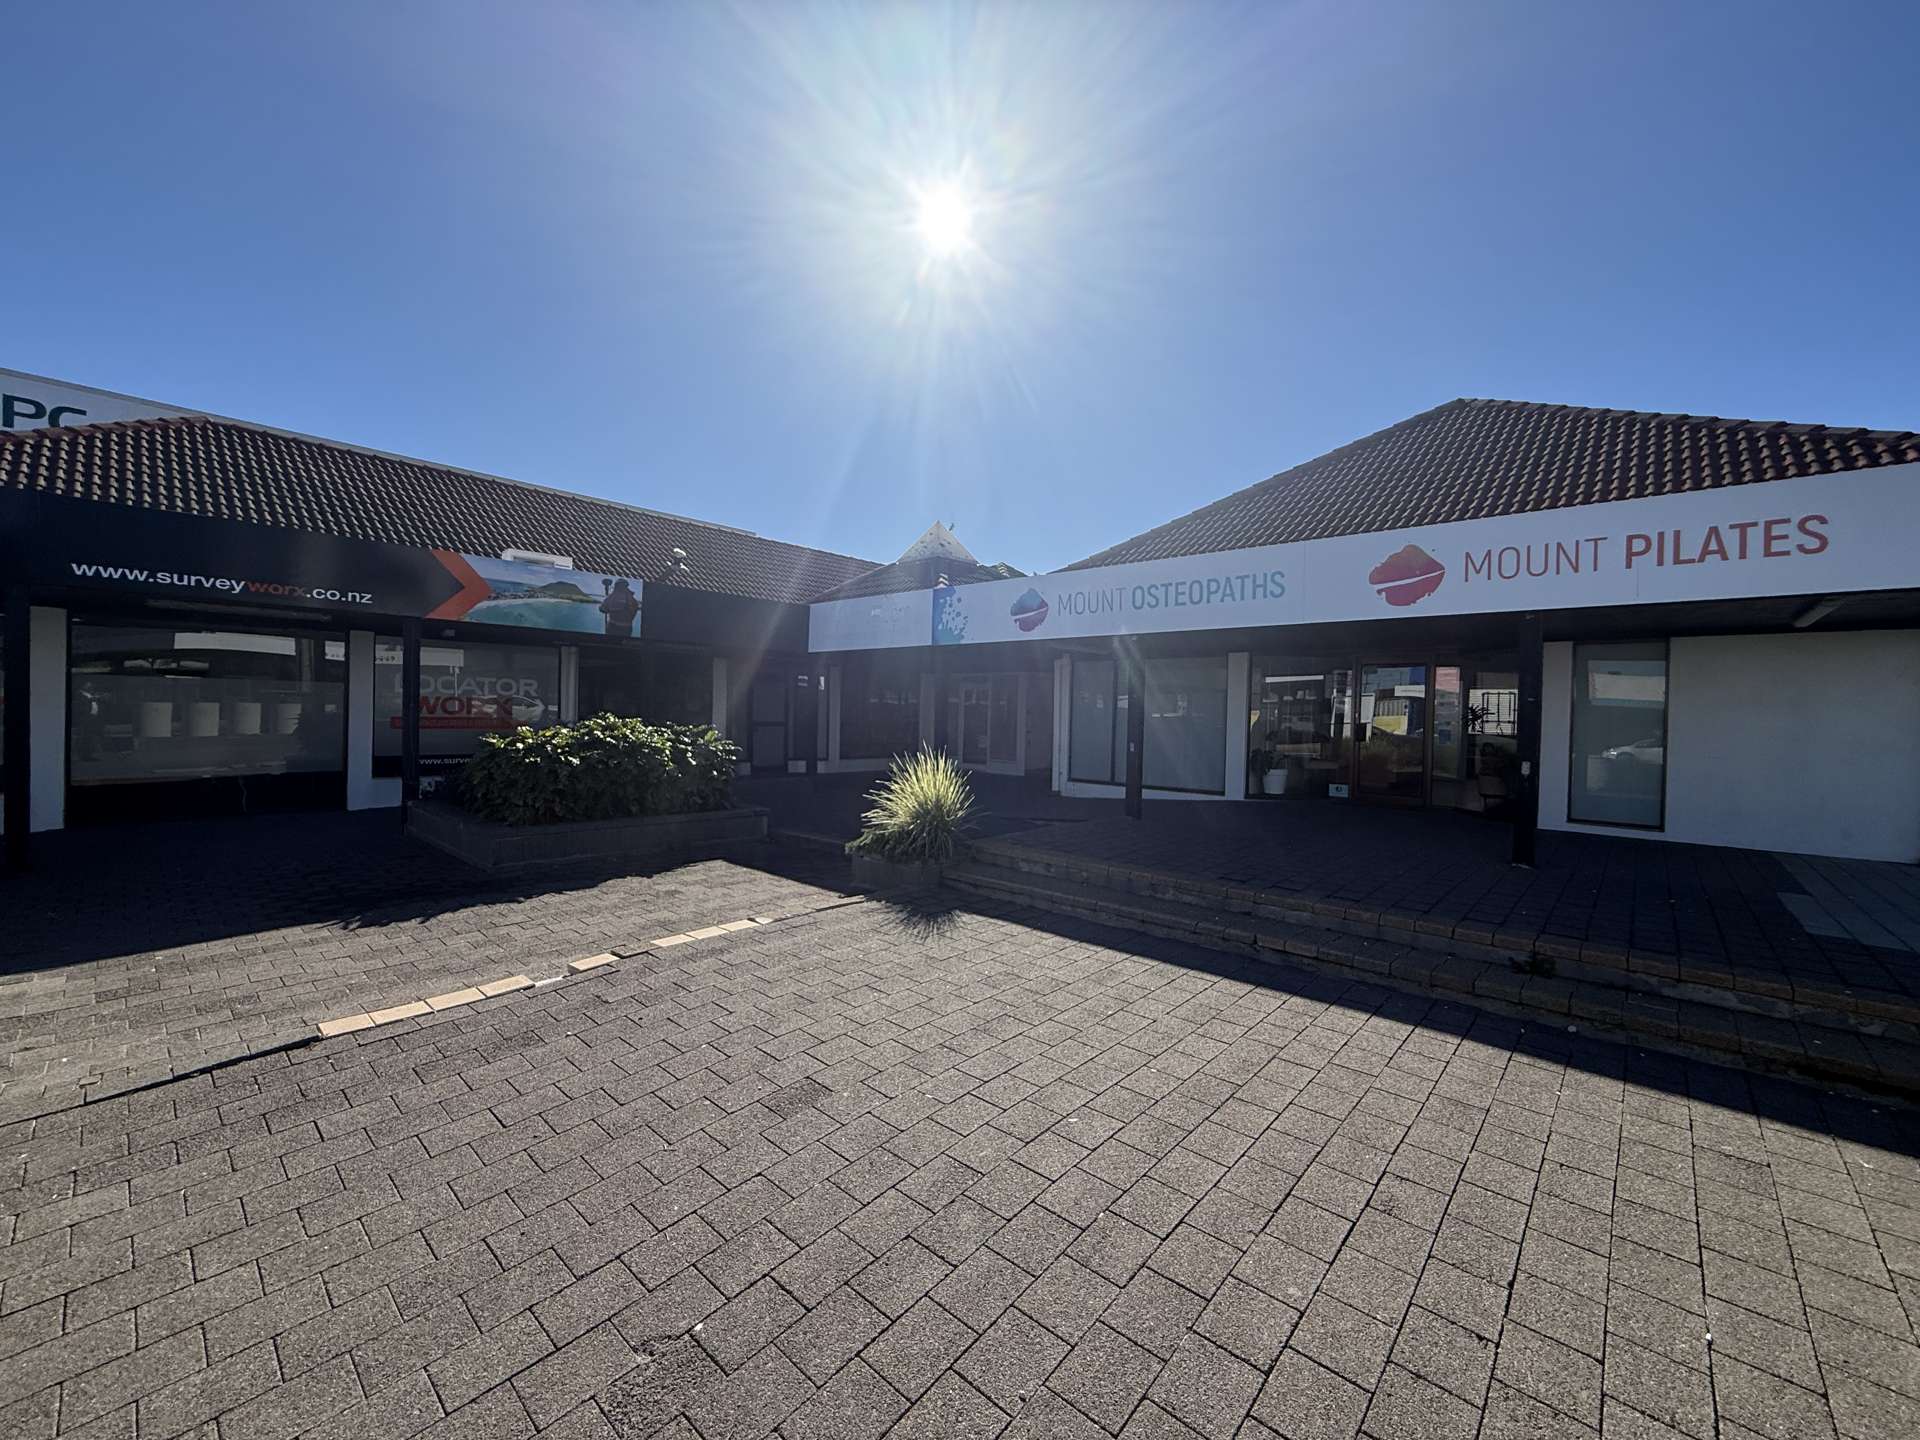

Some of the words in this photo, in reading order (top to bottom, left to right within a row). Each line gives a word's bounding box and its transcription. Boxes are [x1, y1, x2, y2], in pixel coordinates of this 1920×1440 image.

[1464, 536, 1608, 583] MOUNT
[1624, 514, 1830, 569] PILATES
[71, 562, 373, 604] www.surveyworx.co.nz
[1058, 587, 1126, 616] MOUNT
[1131, 570, 1286, 610] OSTEOPATHS
